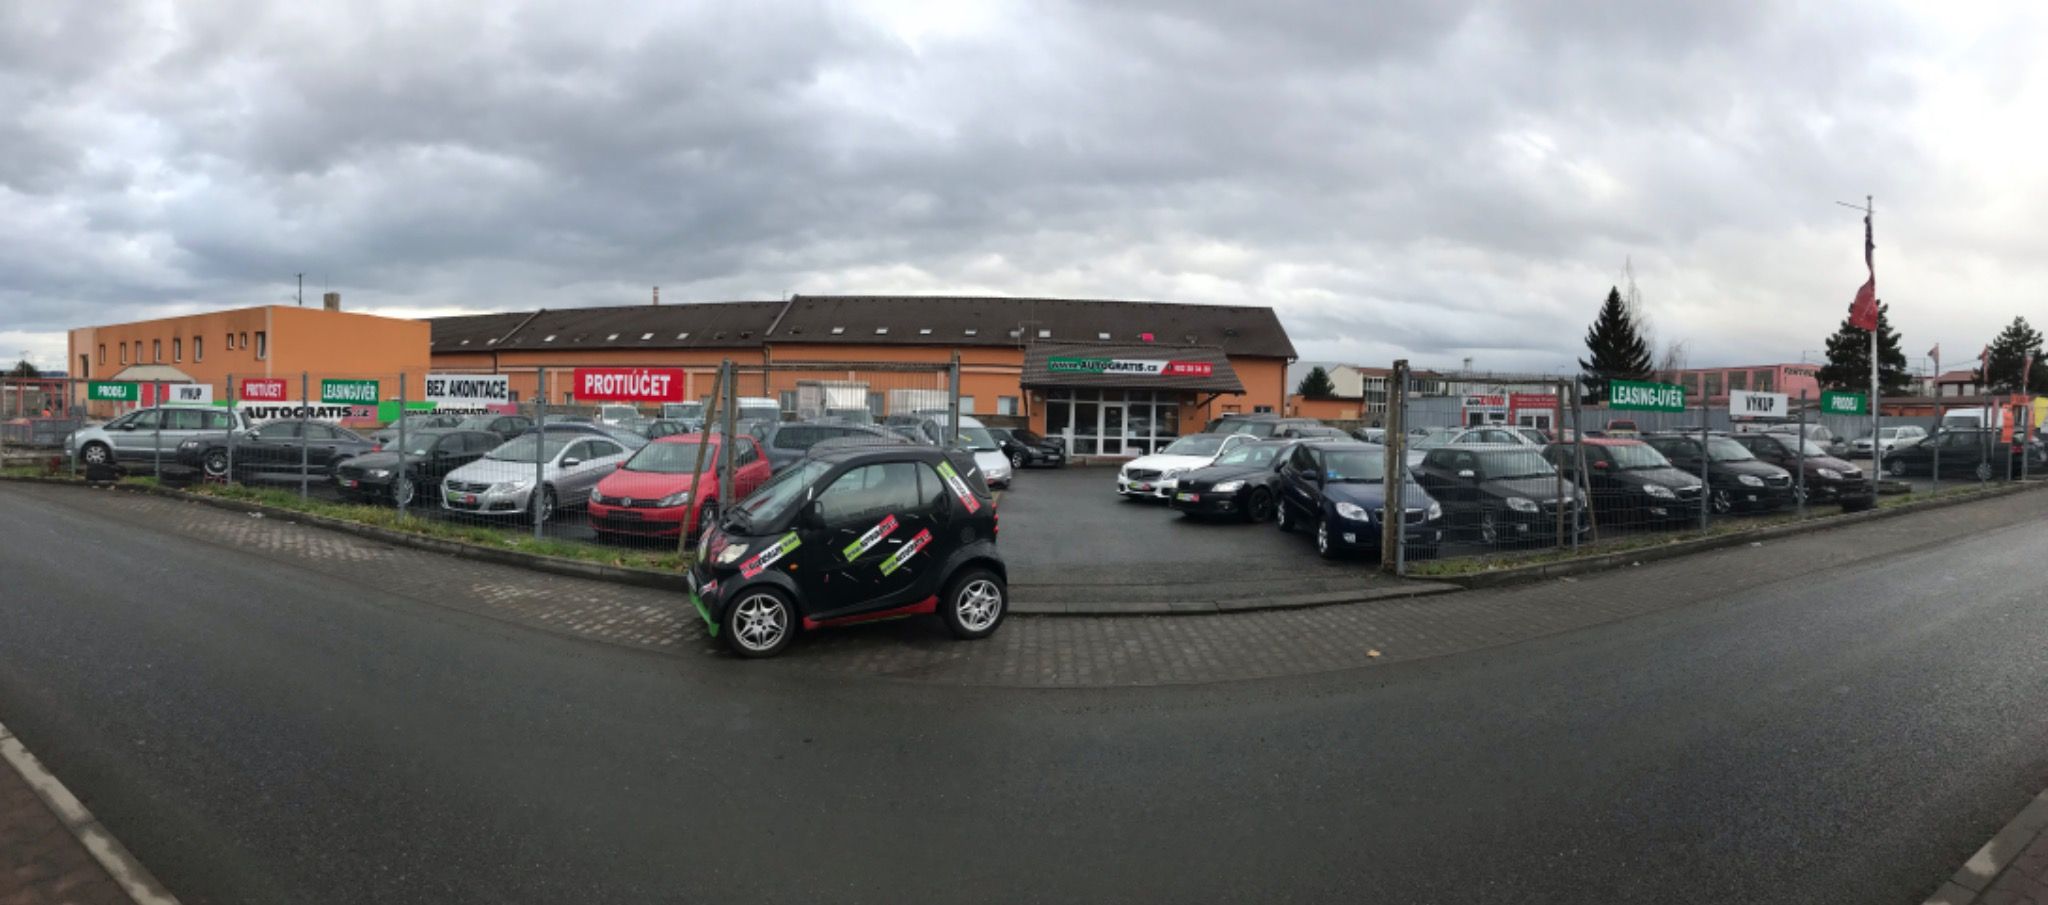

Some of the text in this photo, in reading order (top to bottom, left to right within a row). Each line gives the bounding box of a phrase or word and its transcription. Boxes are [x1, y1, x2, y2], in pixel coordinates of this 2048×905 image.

[97, 385, 127, 398] PRODEJ
[427, 380, 507, 399] BEZ AKONTACE
[585, 369, 671, 396] PROTIÚČET
[1612, 384, 1683, 408] LEASING-ÚVĚR
[1832, 395, 1857, 411] PRODEJ
